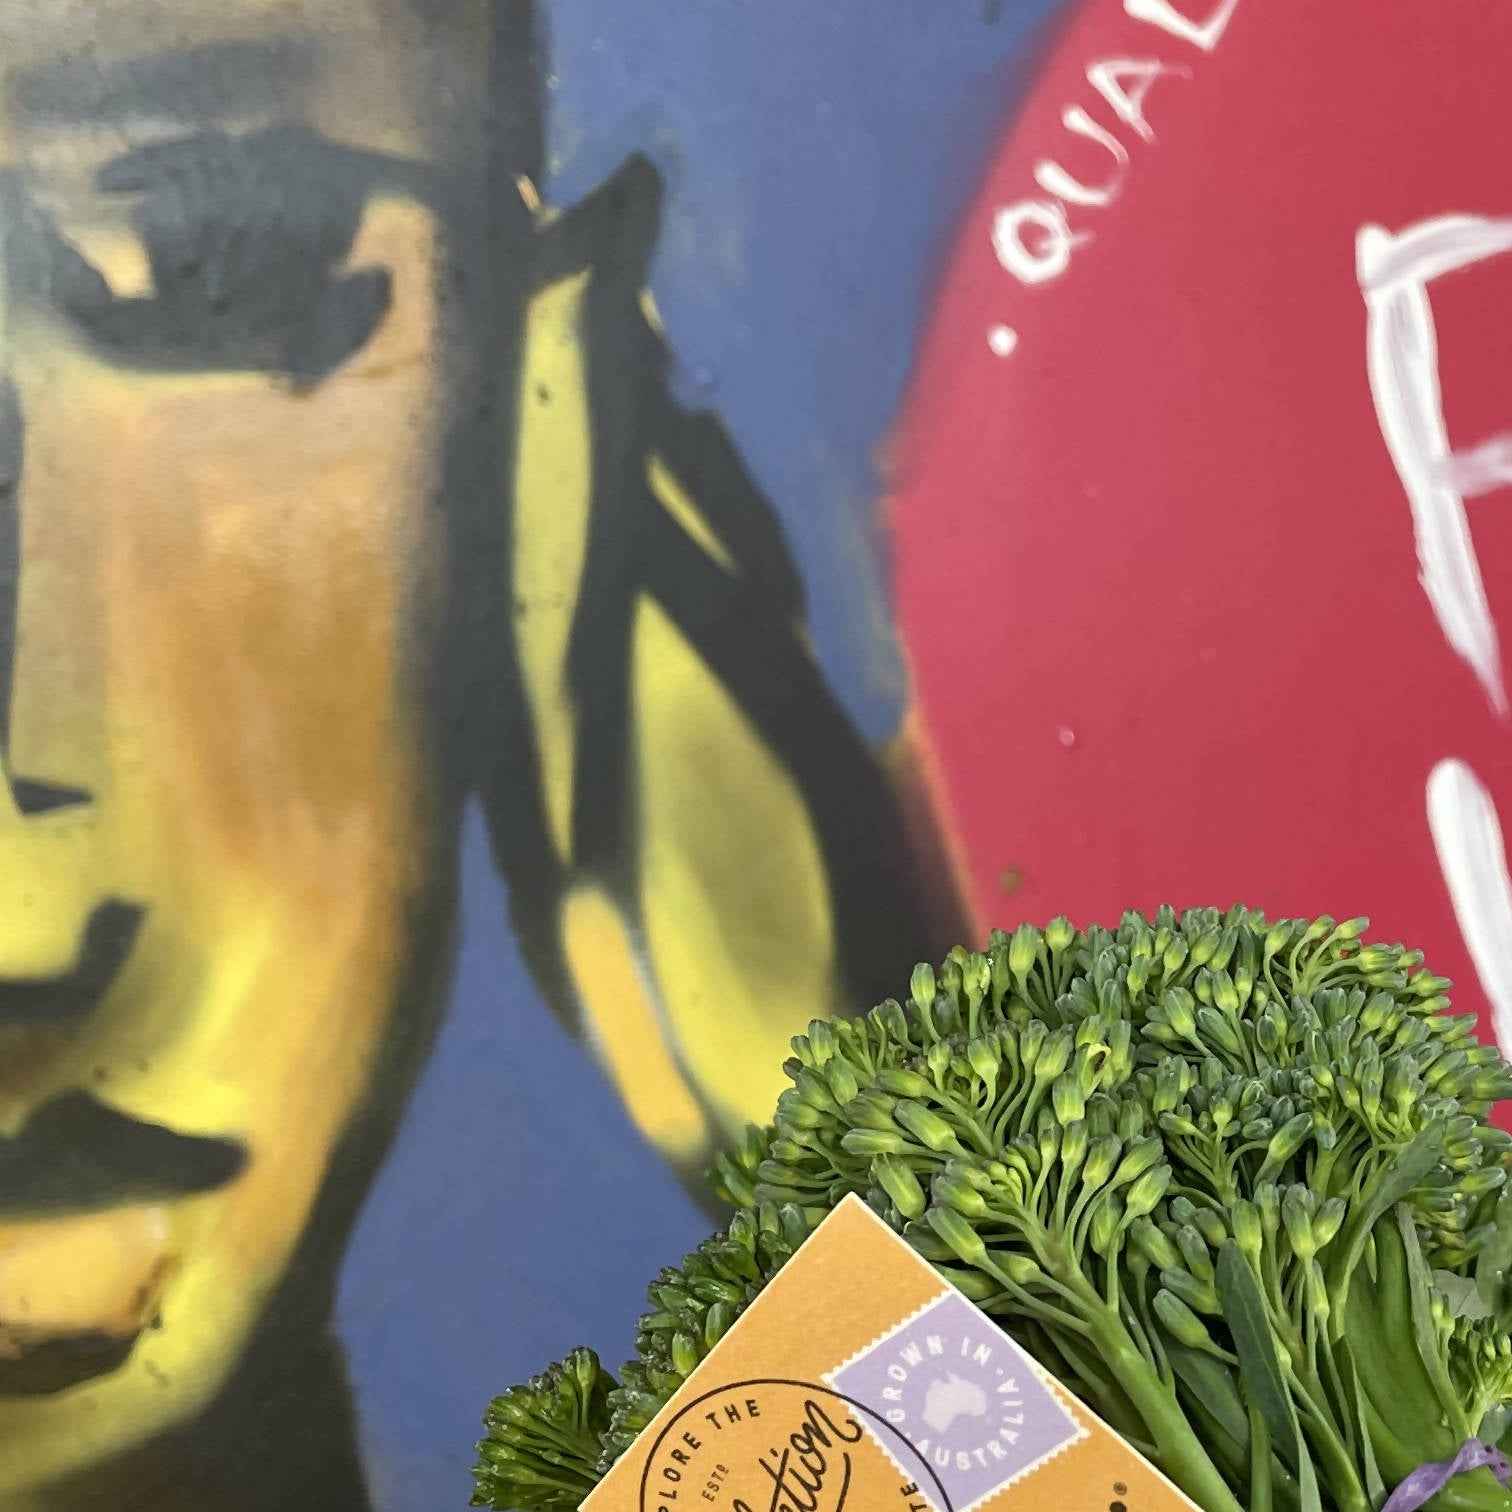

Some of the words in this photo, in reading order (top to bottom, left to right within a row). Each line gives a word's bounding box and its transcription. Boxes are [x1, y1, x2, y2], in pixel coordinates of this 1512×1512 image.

[705, 1398, 761, 1431] THE
[882, 1334, 944, 1423] GROWN
[960, 1336, 992, 1366] IN
[914, 1377, 1024, 1471] AUSTRALIA
